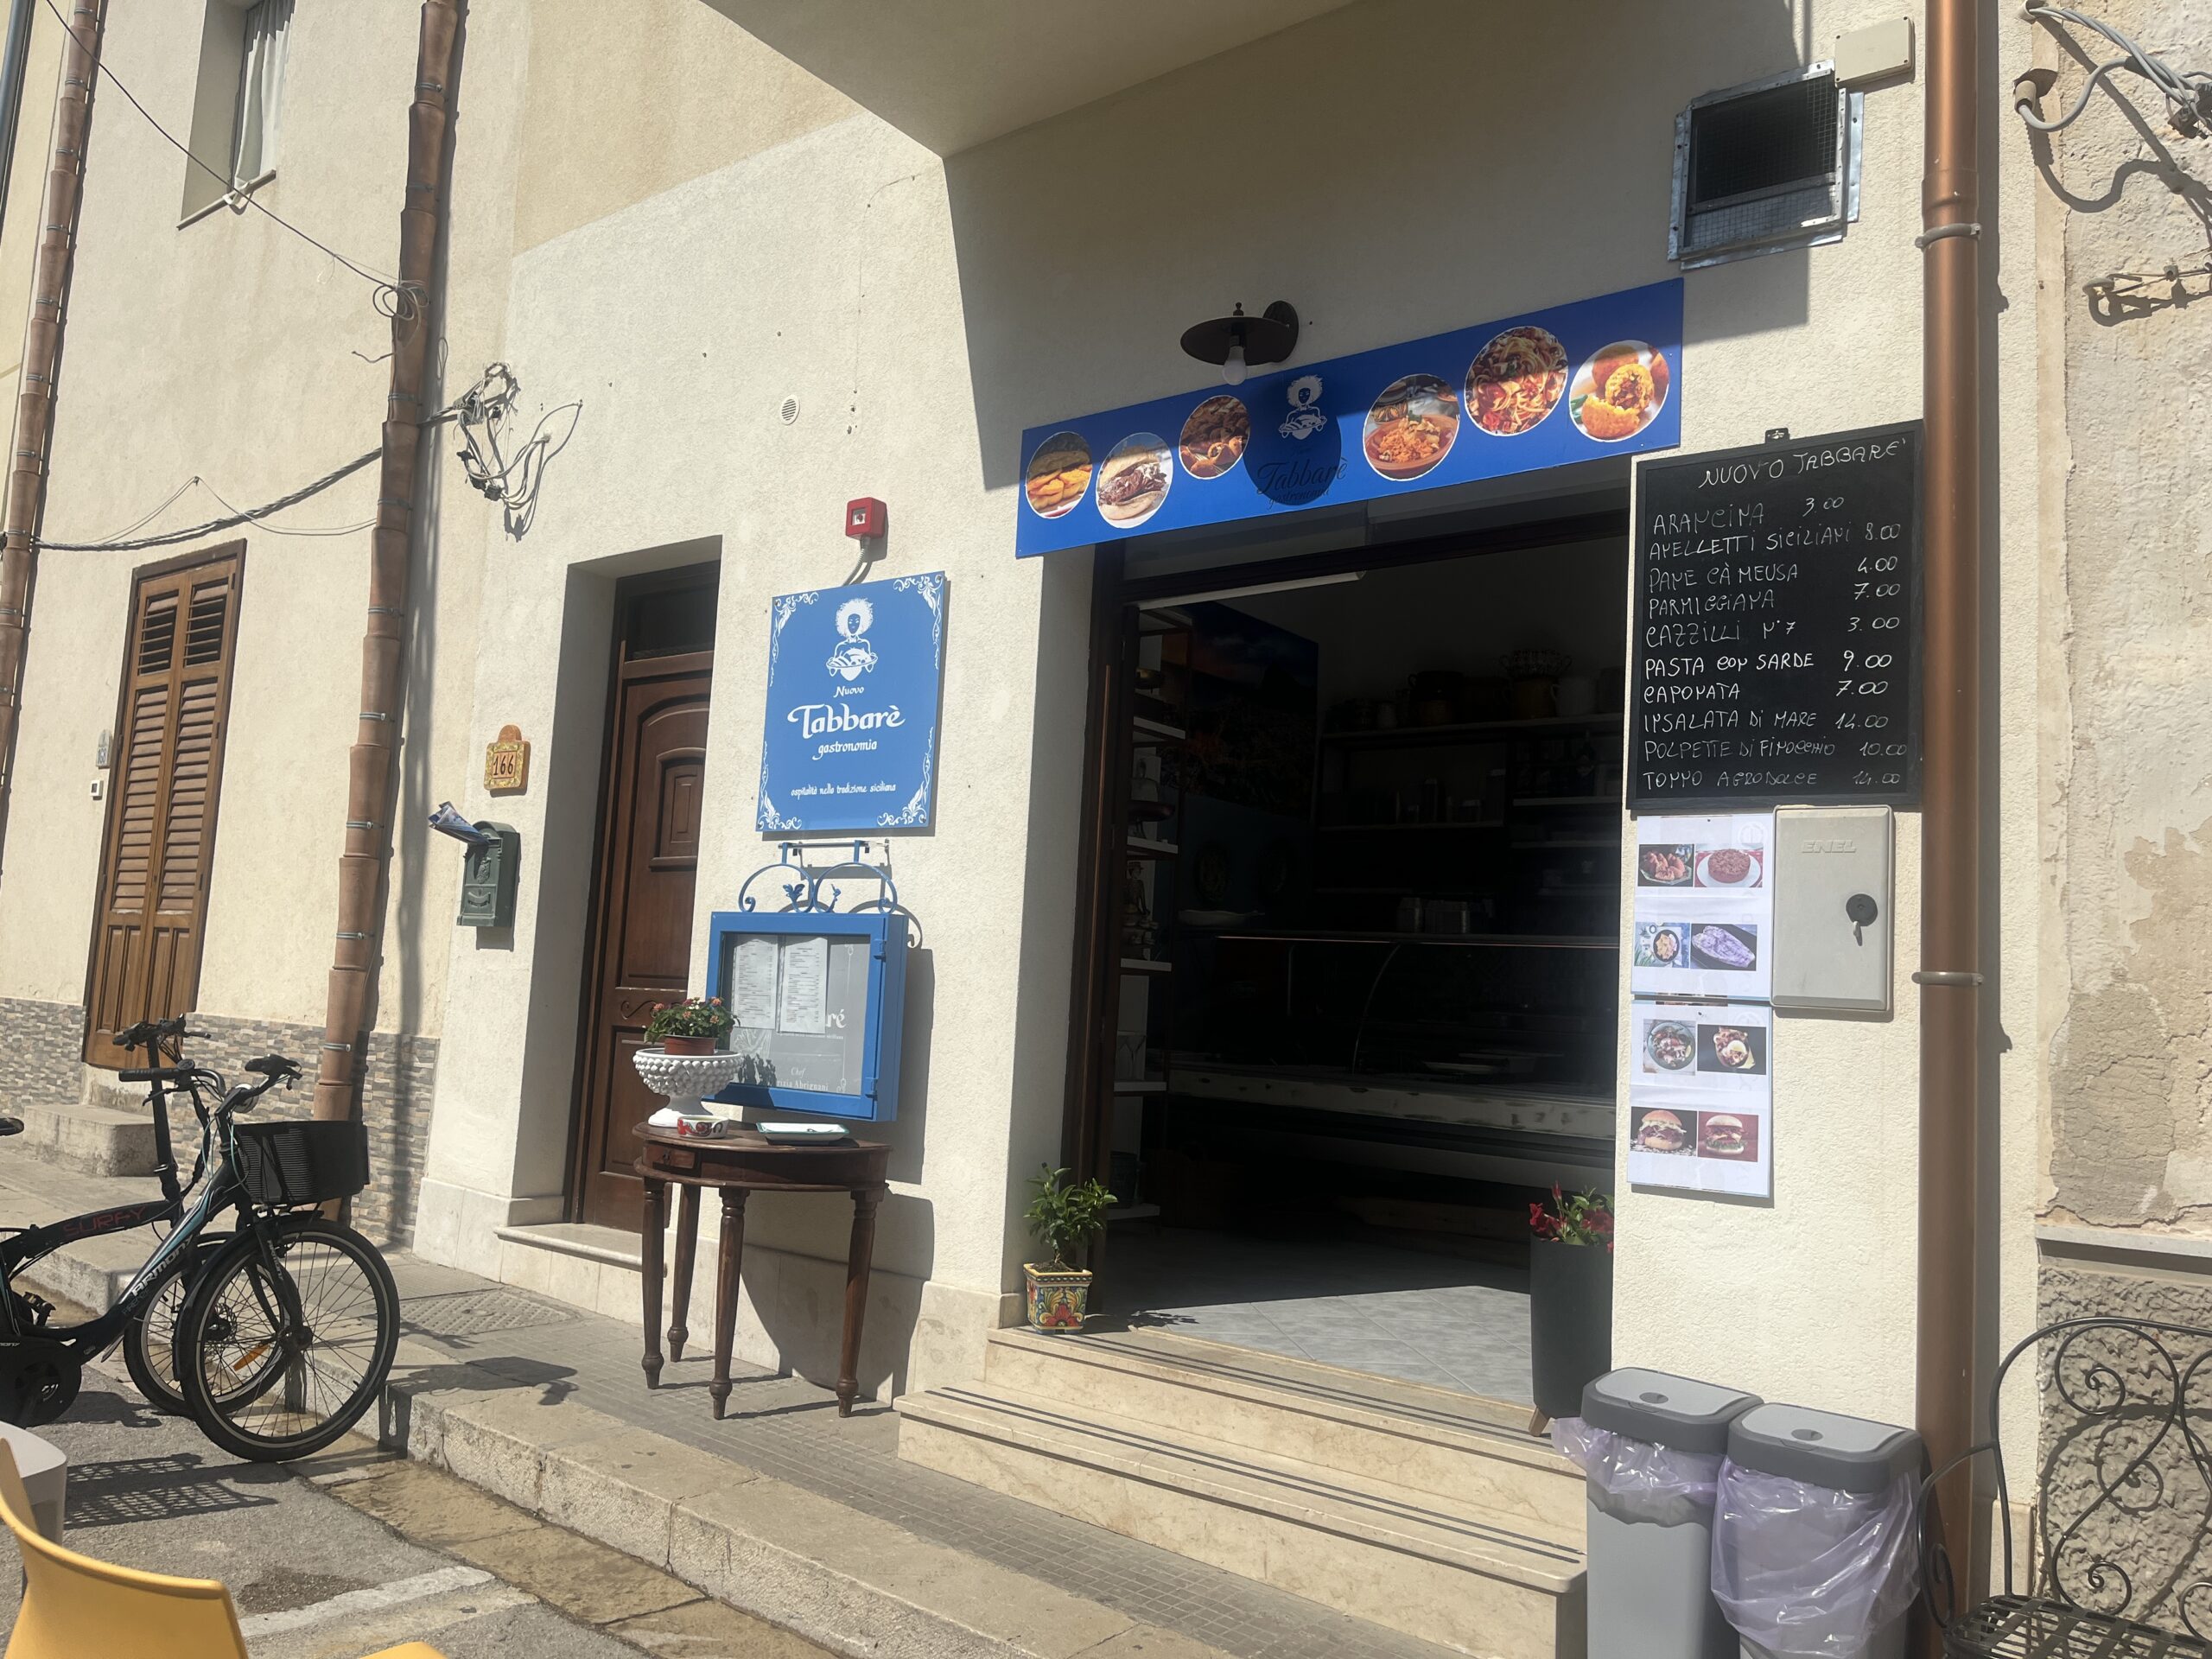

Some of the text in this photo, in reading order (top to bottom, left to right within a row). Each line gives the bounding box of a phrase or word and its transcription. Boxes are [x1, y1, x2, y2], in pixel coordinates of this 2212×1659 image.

[1699, 459, 1783, 488] NUOVO
[1865, 522, 1901, 541] 8.00
[1649, 568, 1697, 593] PANE
[1738, 563, 1798, 583] MEUSA
[1858, 556, 1898, 572] 4.00
[1853, 582, 1900, 601] 7.00
[1847, 617, 1900, 632] 3.00
[1645, 657, 1704, 679] PASTA
[1756, 652, 1815, 670] SARDE
[1843, 650, 1892, 671] 9.00
[833, 685, 865, 698] Nuovo
[1835, 679, 1889, 697] 7.00
[787, 702, 906, 740] Tabbarè
[1644, 709, 1738, 733] INSALATA
[1774, 711, 1817, 728] MARE
[1835, 712, 1889, 729] 14.00
[811, 739, 878, 760] gastronomia
[1644, 740, 1732, 761] POLPETTE
[1859, 742, 1907, 757] 10.00
[493, 754, 514, 776] 166
[791, 779, 897, 800] ospitalità nella tradizione siciliana
[1643, 771, 1702, 791] TONNO
[1801, 840, 1857, 854] ENEL
